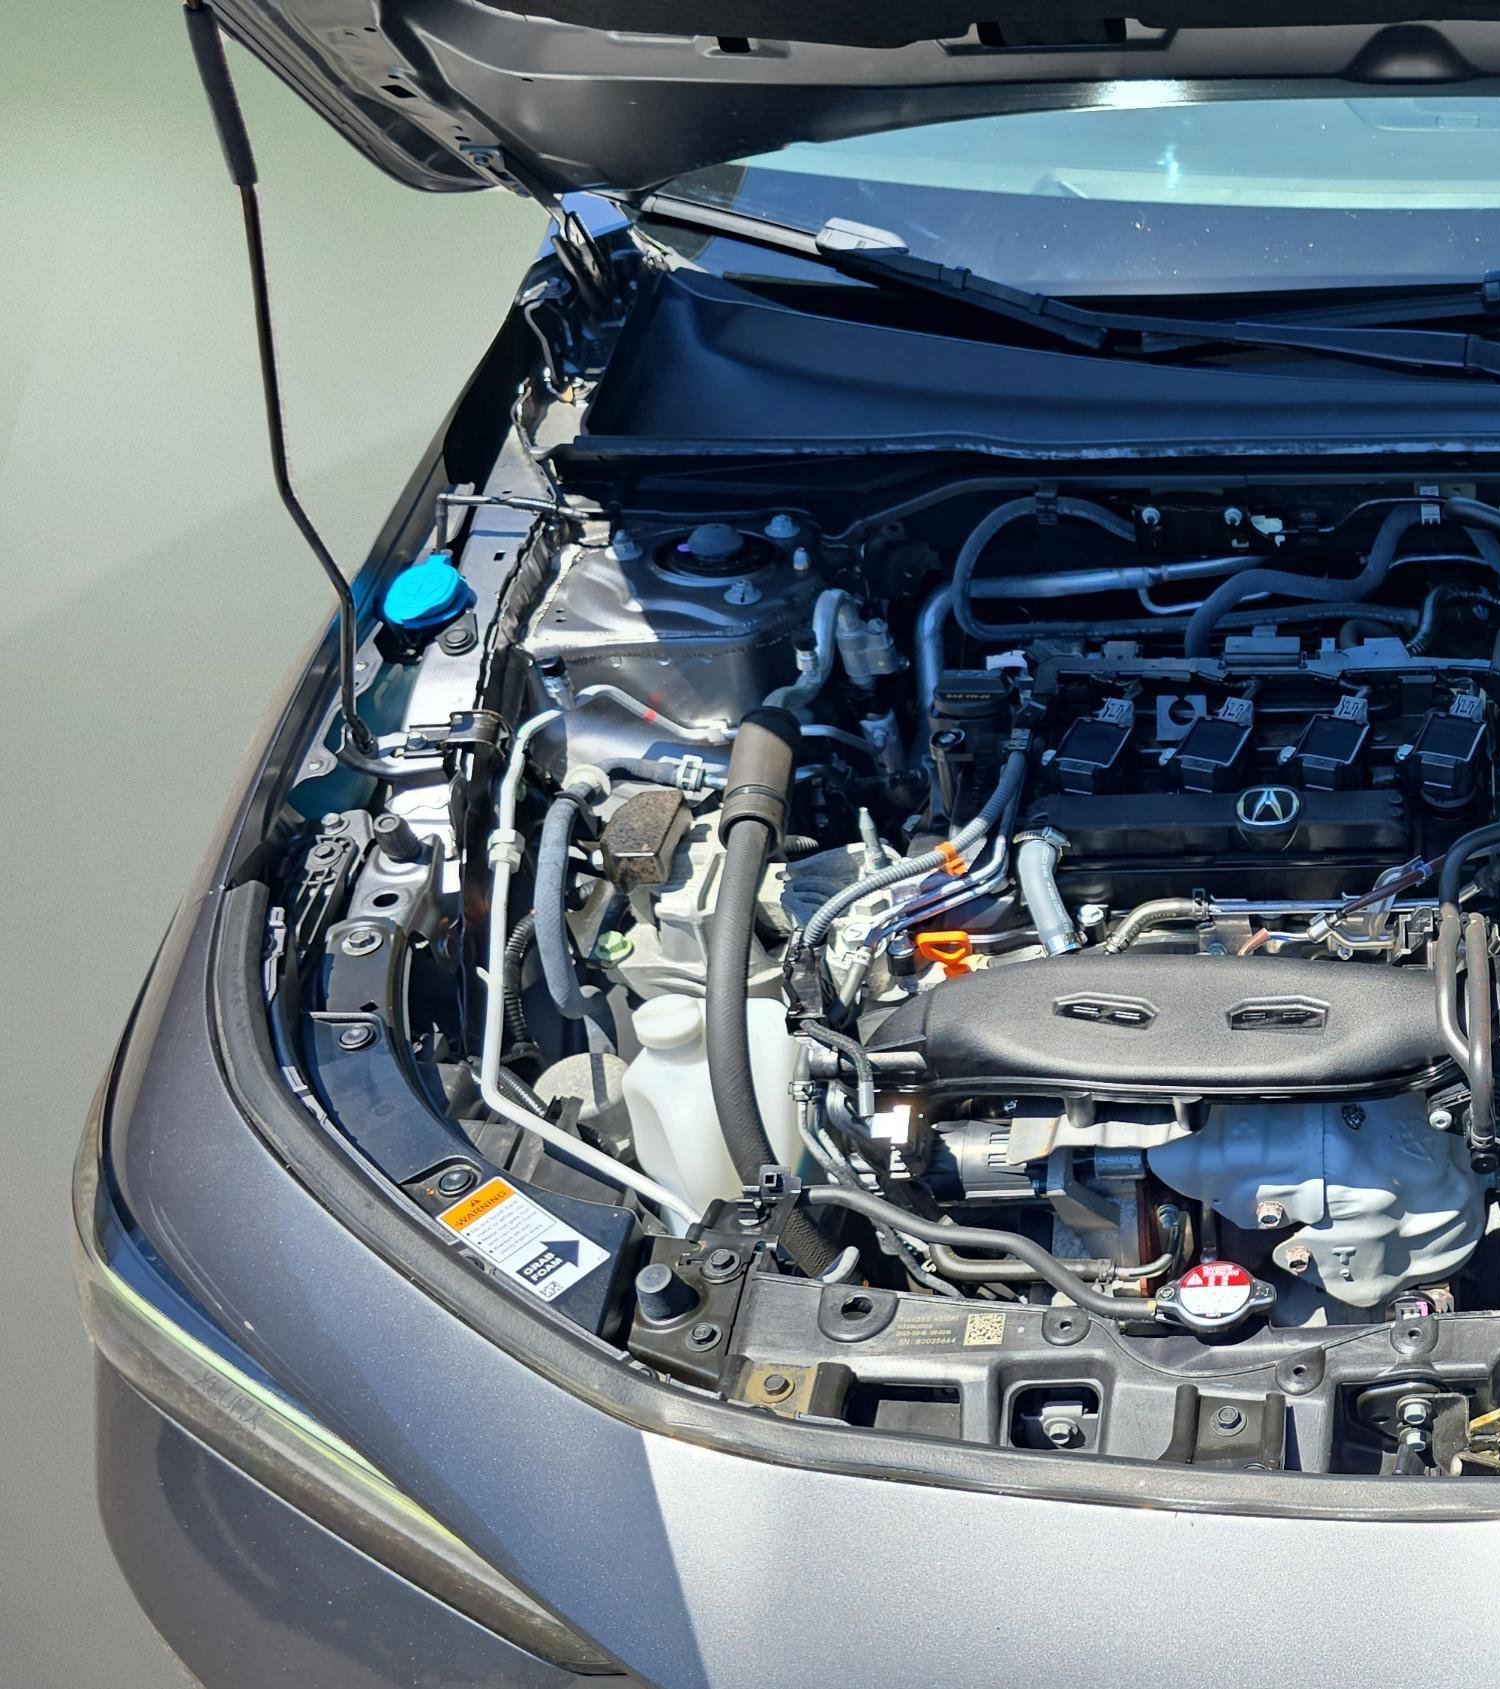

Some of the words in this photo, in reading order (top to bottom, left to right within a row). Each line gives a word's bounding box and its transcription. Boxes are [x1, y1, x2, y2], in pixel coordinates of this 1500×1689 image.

[456, 1190, 508, 1226] WARNING
[523, 1252, 556, 1276] GRAB
[530, 1256, 564, 1282] FOAM
